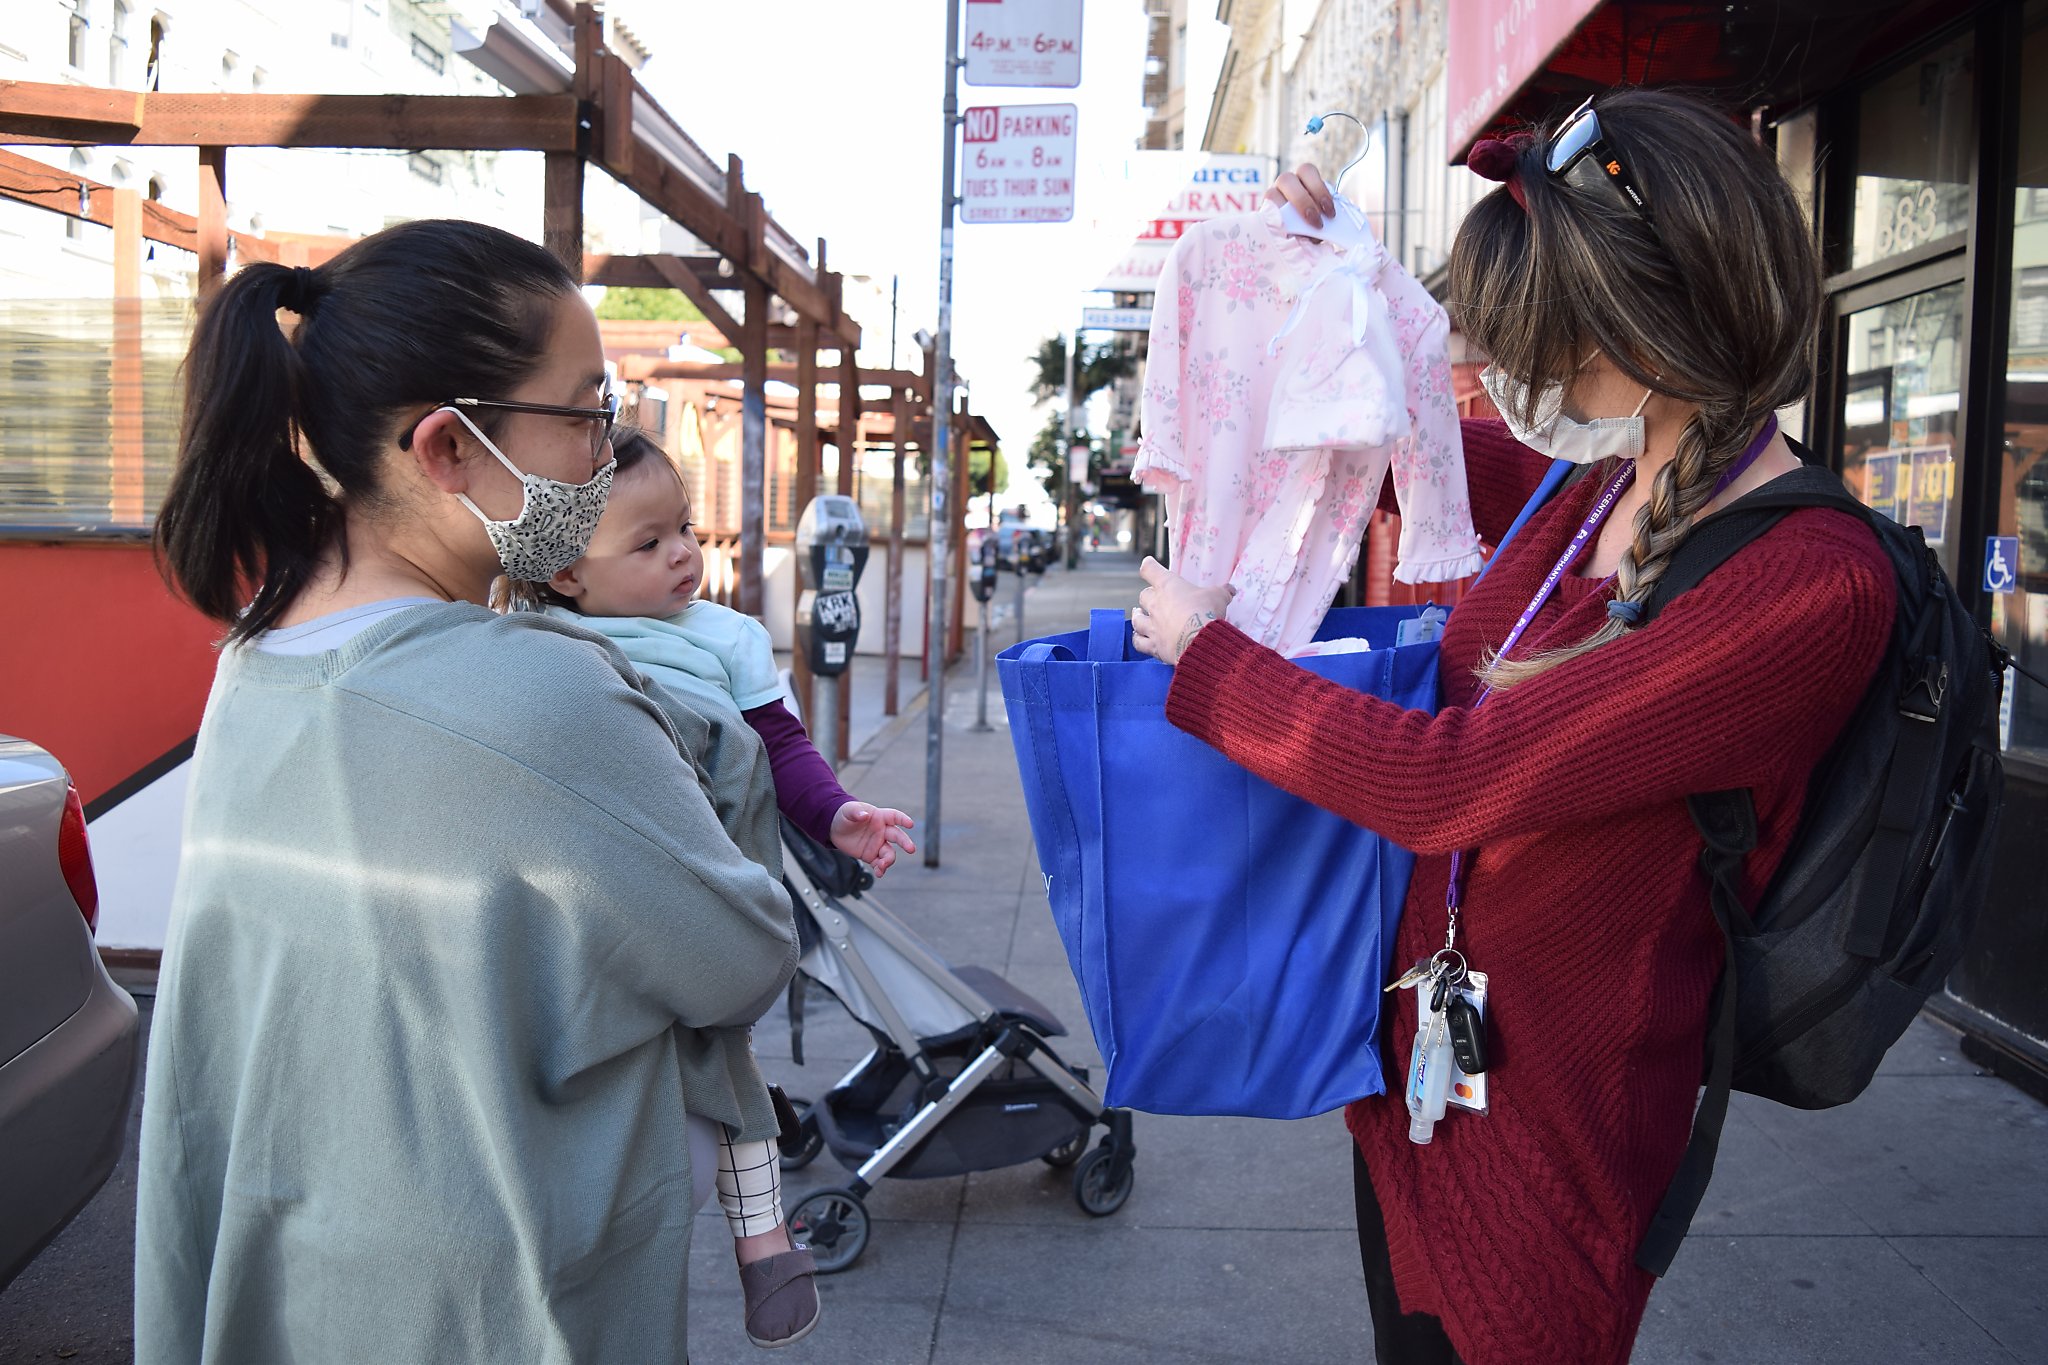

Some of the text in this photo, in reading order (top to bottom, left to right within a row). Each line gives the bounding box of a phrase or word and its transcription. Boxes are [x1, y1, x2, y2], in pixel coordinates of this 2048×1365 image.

[971, 32, 1015, 52] 4P.M.
[1033, 32, 1076, 54] 6P.M.
[966, 108, 1071, 141] NO PARKING
[1193, 166, 1260, 184] urca
[966, 176, 1071, 197] TUES THUR SUN
[1625, 185, 1643, 207] MAVERICK
[1166, 190, 1263, 212] URANT
[969, 206, 1007, 219] STREET
[1875, 186, 1937, 254] 883
[1588, 460, 1636, 525] PIPHANY CENTER
[1526, 544, 1577, 612] EPIPHANY CENTER
